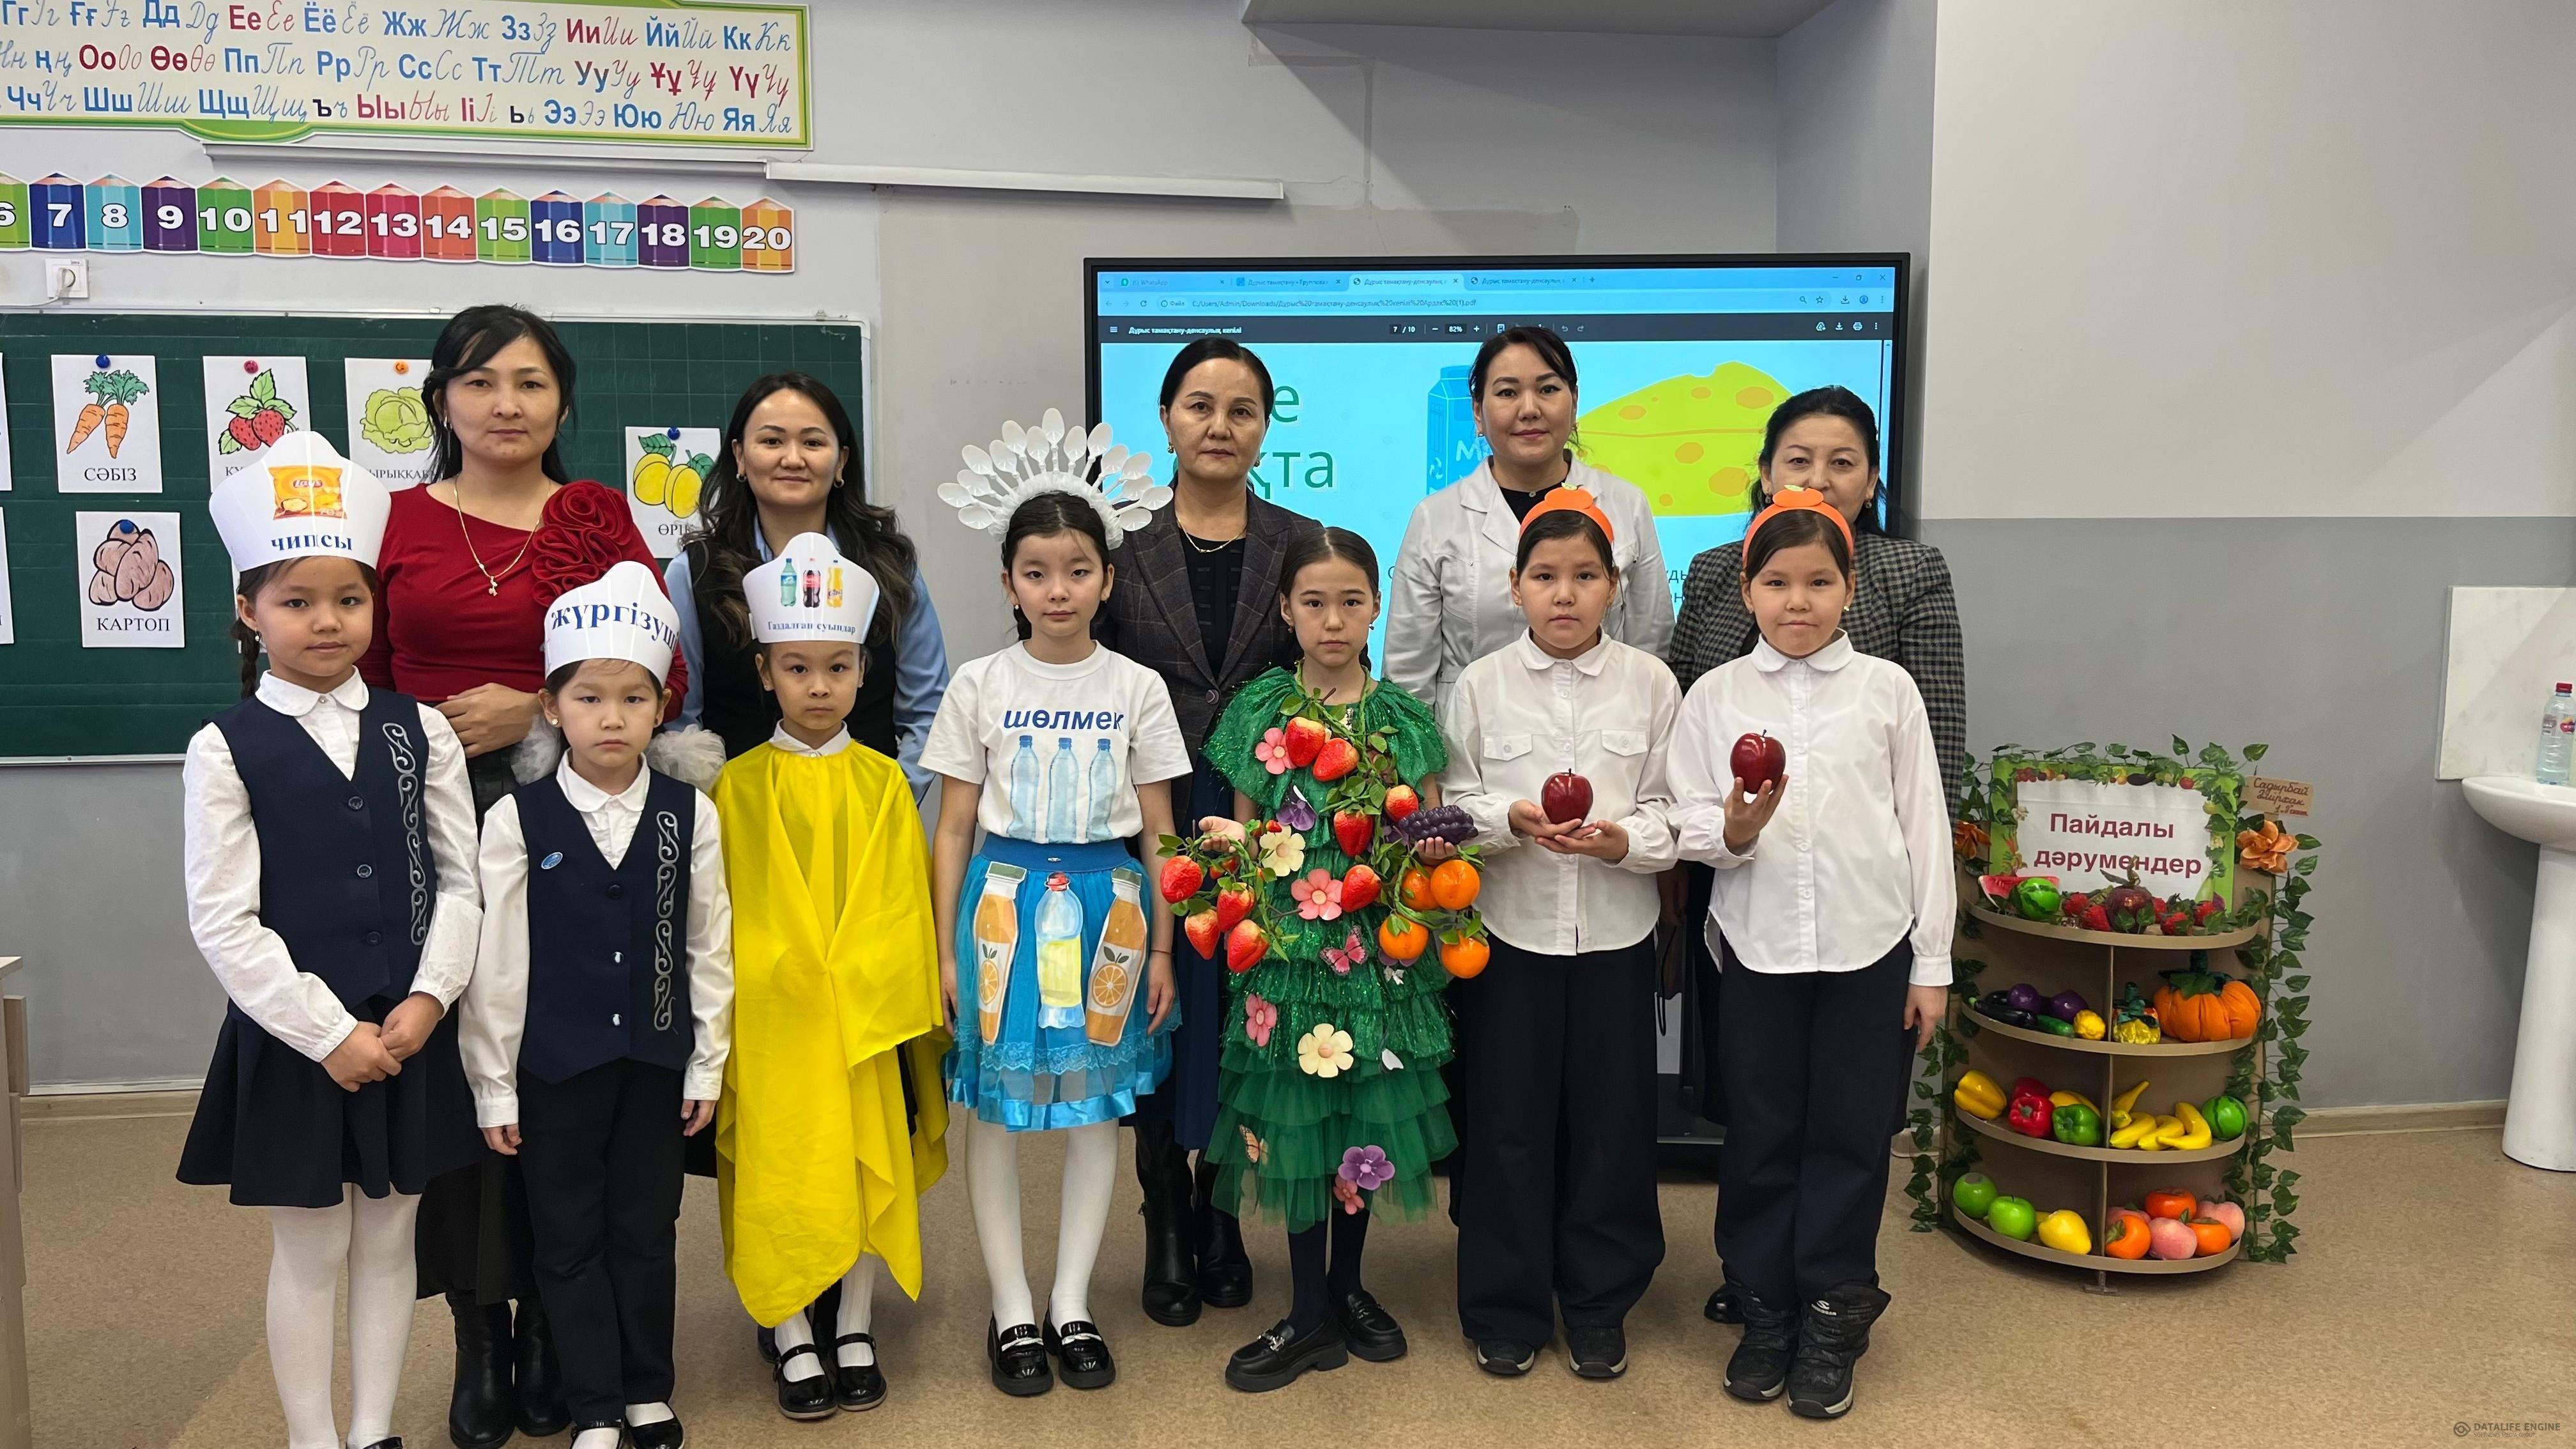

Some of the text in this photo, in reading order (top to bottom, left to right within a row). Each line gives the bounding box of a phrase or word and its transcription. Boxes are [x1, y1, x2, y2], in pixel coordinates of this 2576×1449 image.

[47, 203, 73, 227] 7
[101, 203, 128, 228] 8
[158, 204, 184, 229] 9
[199, 207, 252, 232] 10
[259, 208, 308, 233] 11
[313, 210, 364, 235] 12
[371, 211, 418, 237] 13
[424, 214, 472, 239] 14
[480, 217, 528, 241] 15
[534, 218, 581, 243] 16
[589, 221, 634, 245] 17
[641, 222, 687, 247] 18
[693, 225, 739, 249] 19
[742, 226, 792, 250] 20
[84, 468, 137, 482] СӘБІЗ
[271, 534, 353, 551] чипсы
[96, 617, 170, 631] КАРТОП
[1003, 709, 1124, 730] шөлмек
[2050, 813, 2174, 838] Пайдалы
[2034, 850, 2202, 878] дәрумендер
